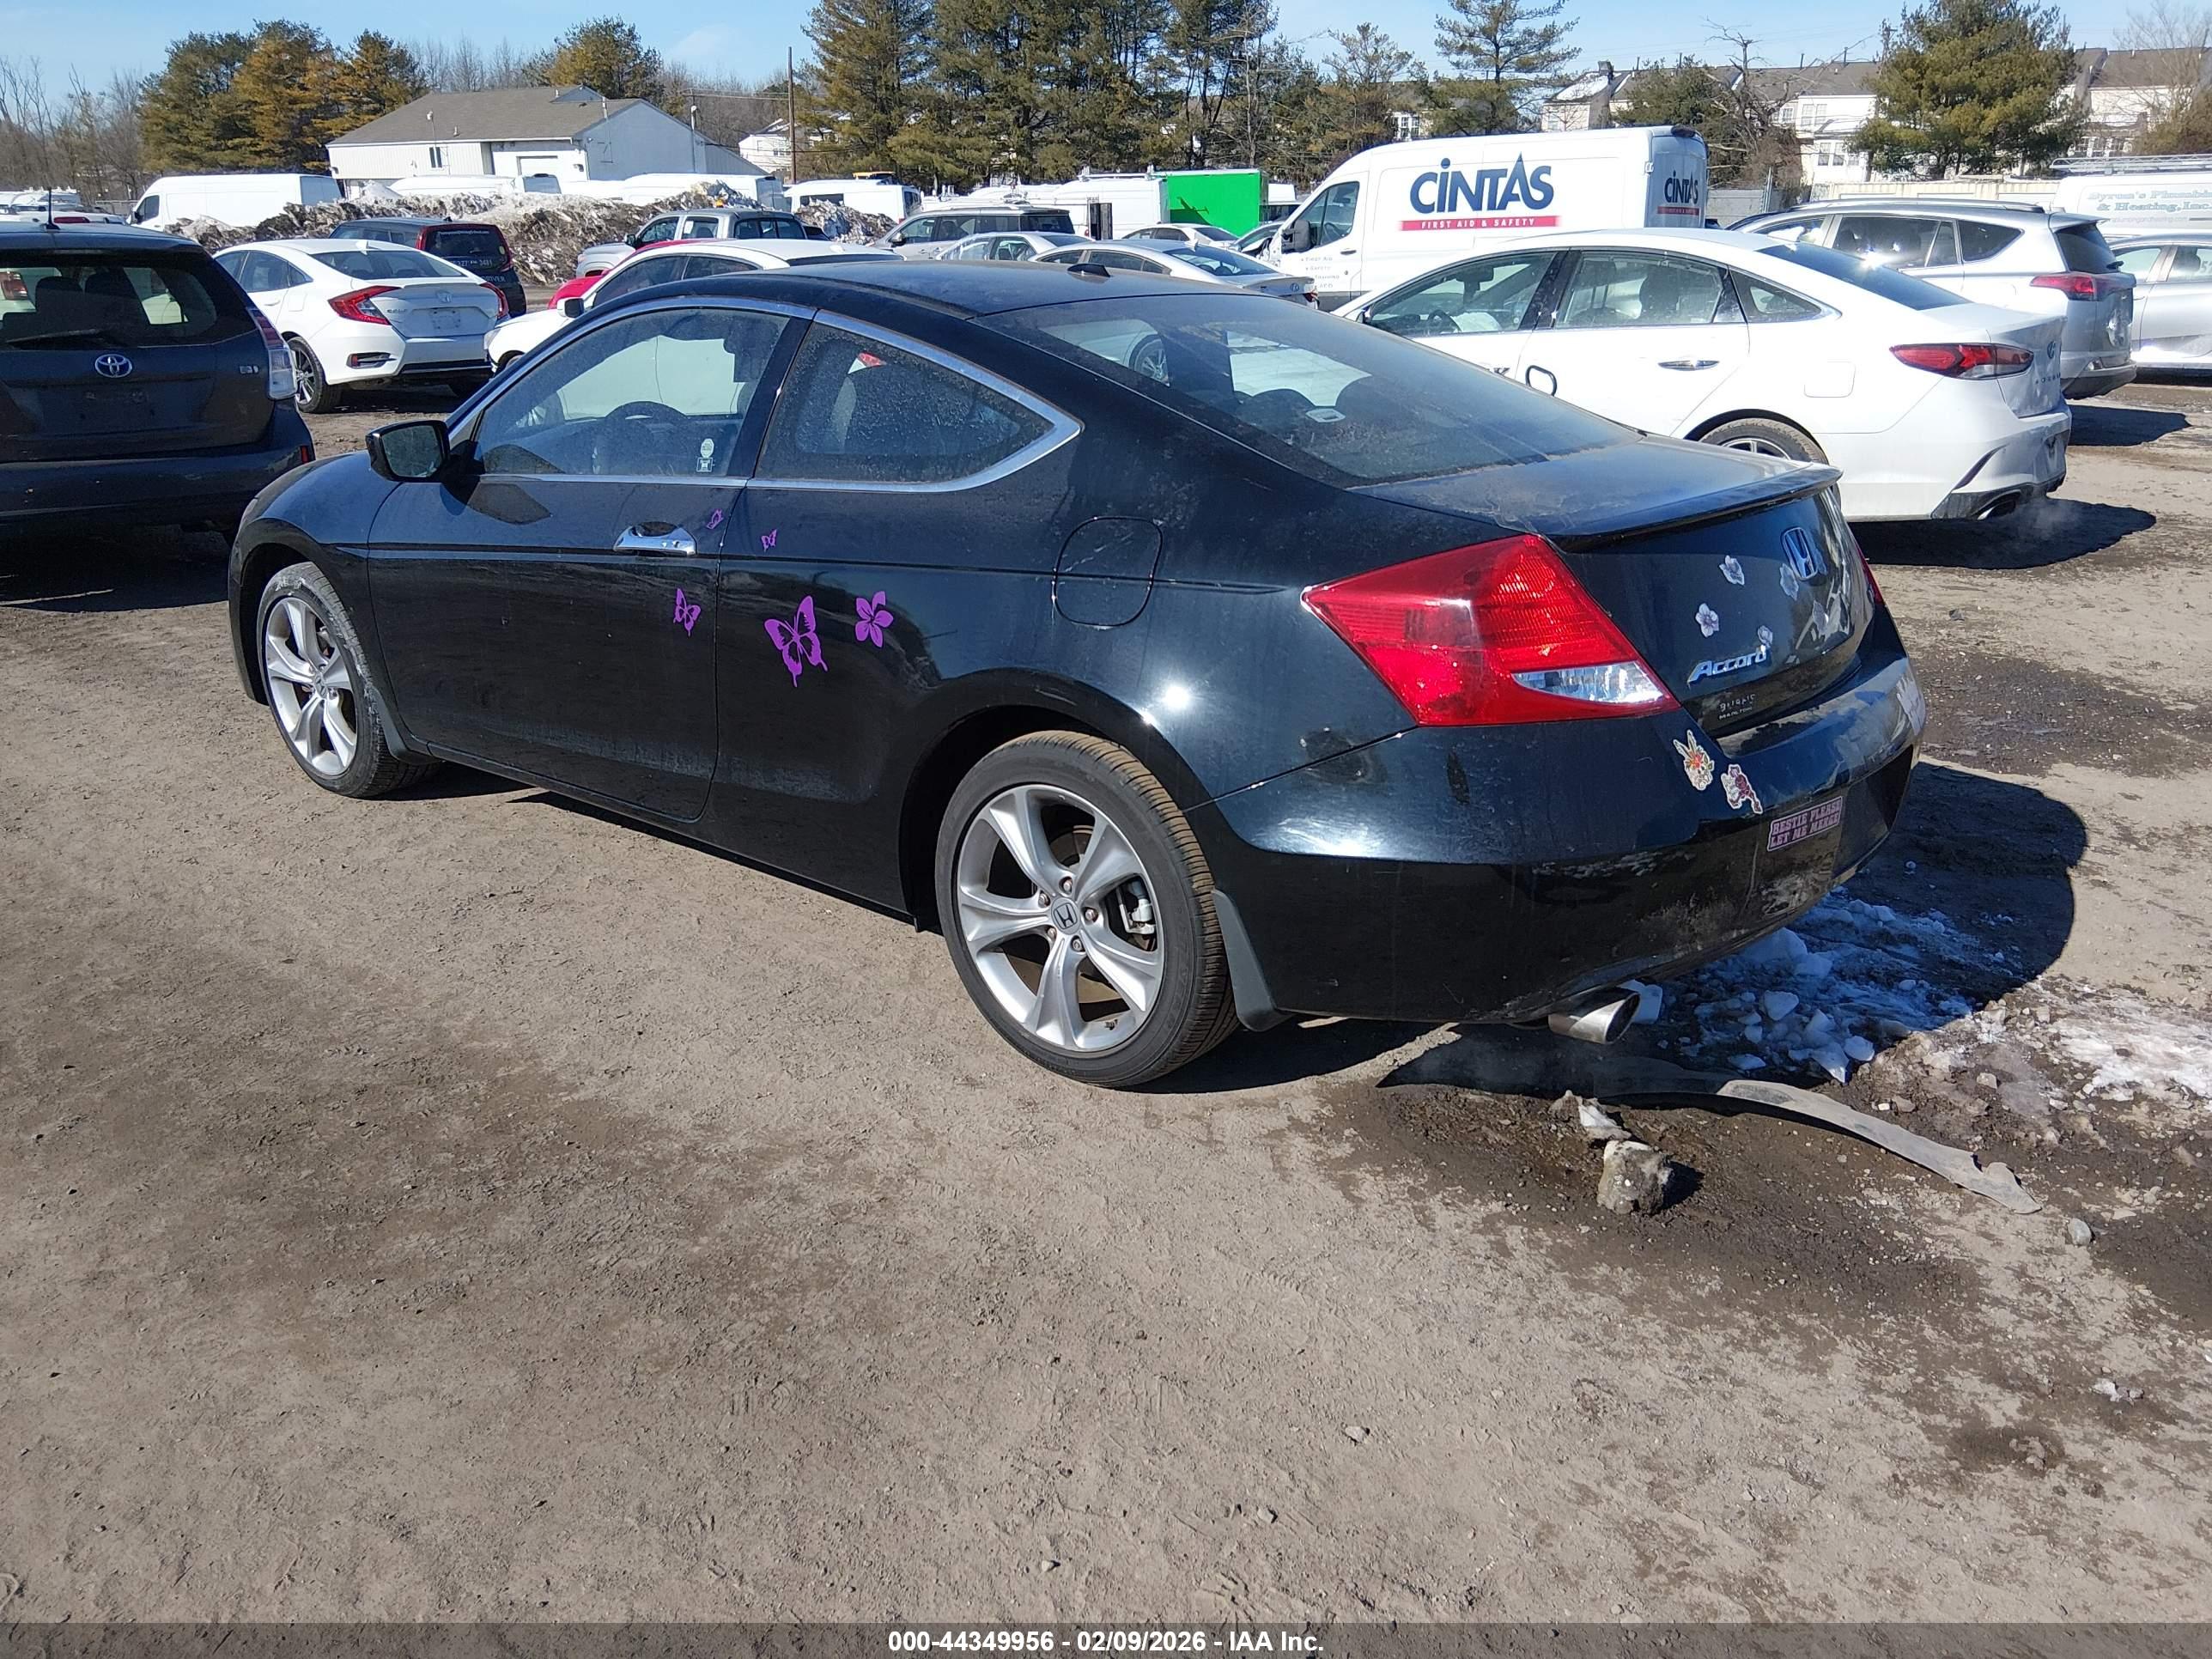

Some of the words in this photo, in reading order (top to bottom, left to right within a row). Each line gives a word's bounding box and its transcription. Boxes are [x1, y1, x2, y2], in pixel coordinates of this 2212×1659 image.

[1420, 219, 1451, 229] FIRST
[1456, 218, 1475, 228] AID
[1481, 218, 1488, 227] &
[1494, 217, 1535, 227] SAFETY
[1686, 644, 1767, 685] Accord
[1770, 831, 1790, 848] LET
[1792, 824, 1808, 841] ME
[1809, 812, 1839, 834] MERGE
[1772, 812, 1808, 836] BESTIE
[1810, 799, 1842, 822] PLEASE
